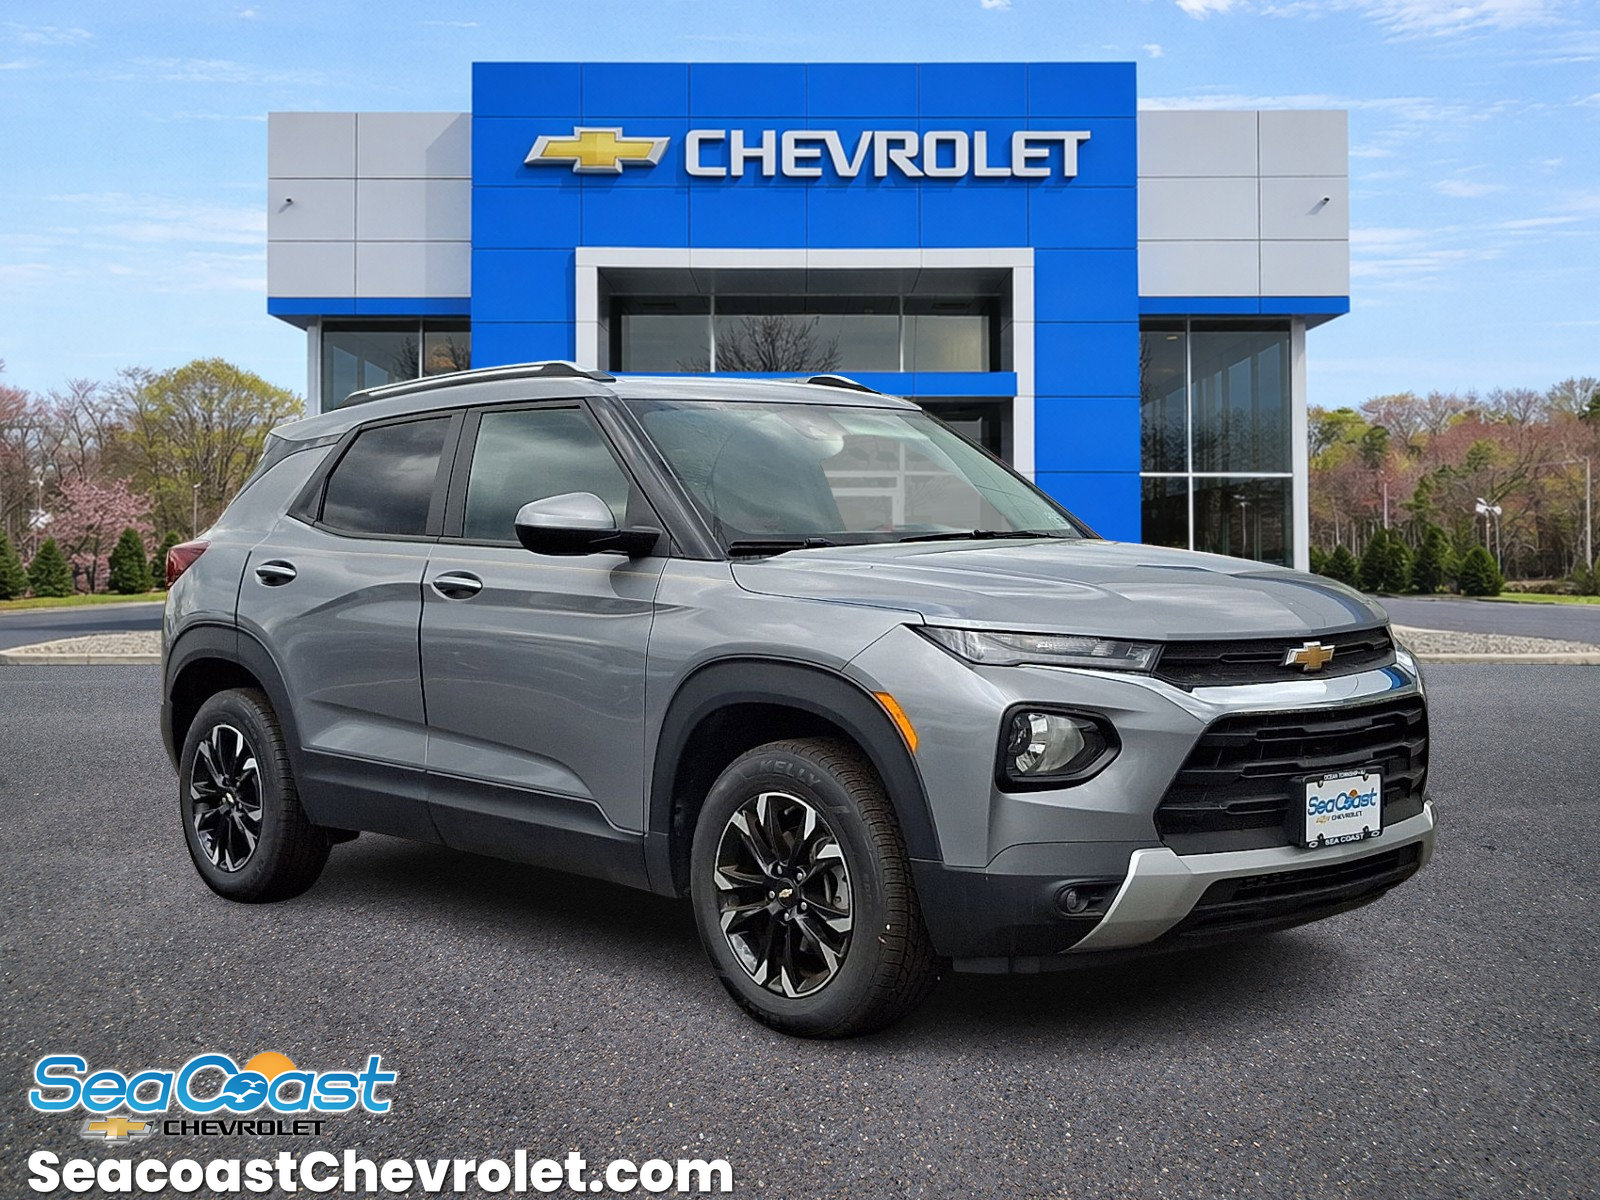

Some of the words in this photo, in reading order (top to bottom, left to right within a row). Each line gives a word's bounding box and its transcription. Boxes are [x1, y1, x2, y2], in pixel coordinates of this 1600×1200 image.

[685, 129, 1091, 178] CHEVROLET
[759, 759, 821, 786] KELLY
[1331, 810, 1363, 821] CHEVROLET
[1325, 836, 1340, 845] SEA
[1340, 833, 1364, 843] COAST
